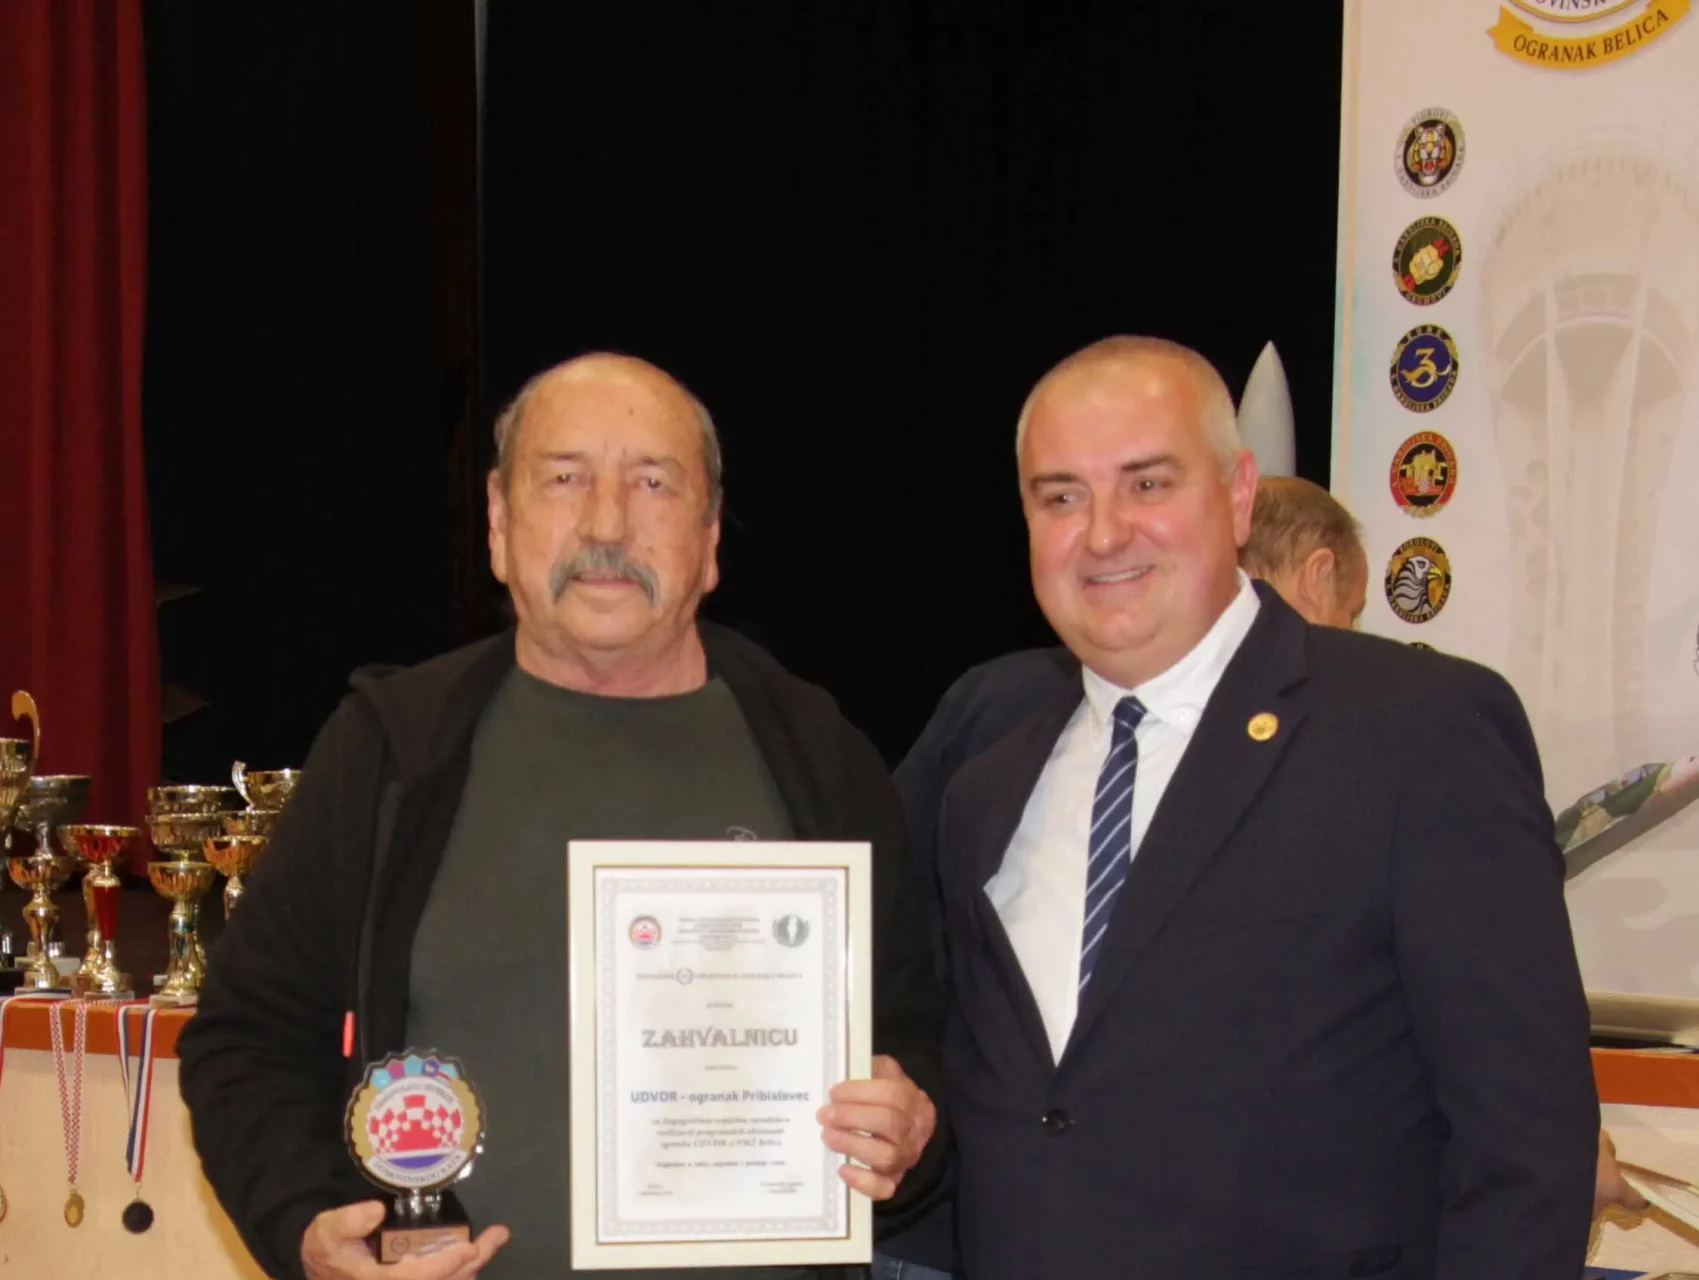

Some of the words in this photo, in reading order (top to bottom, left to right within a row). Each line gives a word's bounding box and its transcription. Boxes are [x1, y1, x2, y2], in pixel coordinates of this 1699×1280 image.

[1513, 34, 1598, 62] OGRANAK
[1603, 9, 1669, 55] BELICA
[1402, 347, 1438, 388] 3
[641, 1027, 798, 1048] ZAHVALNICU
